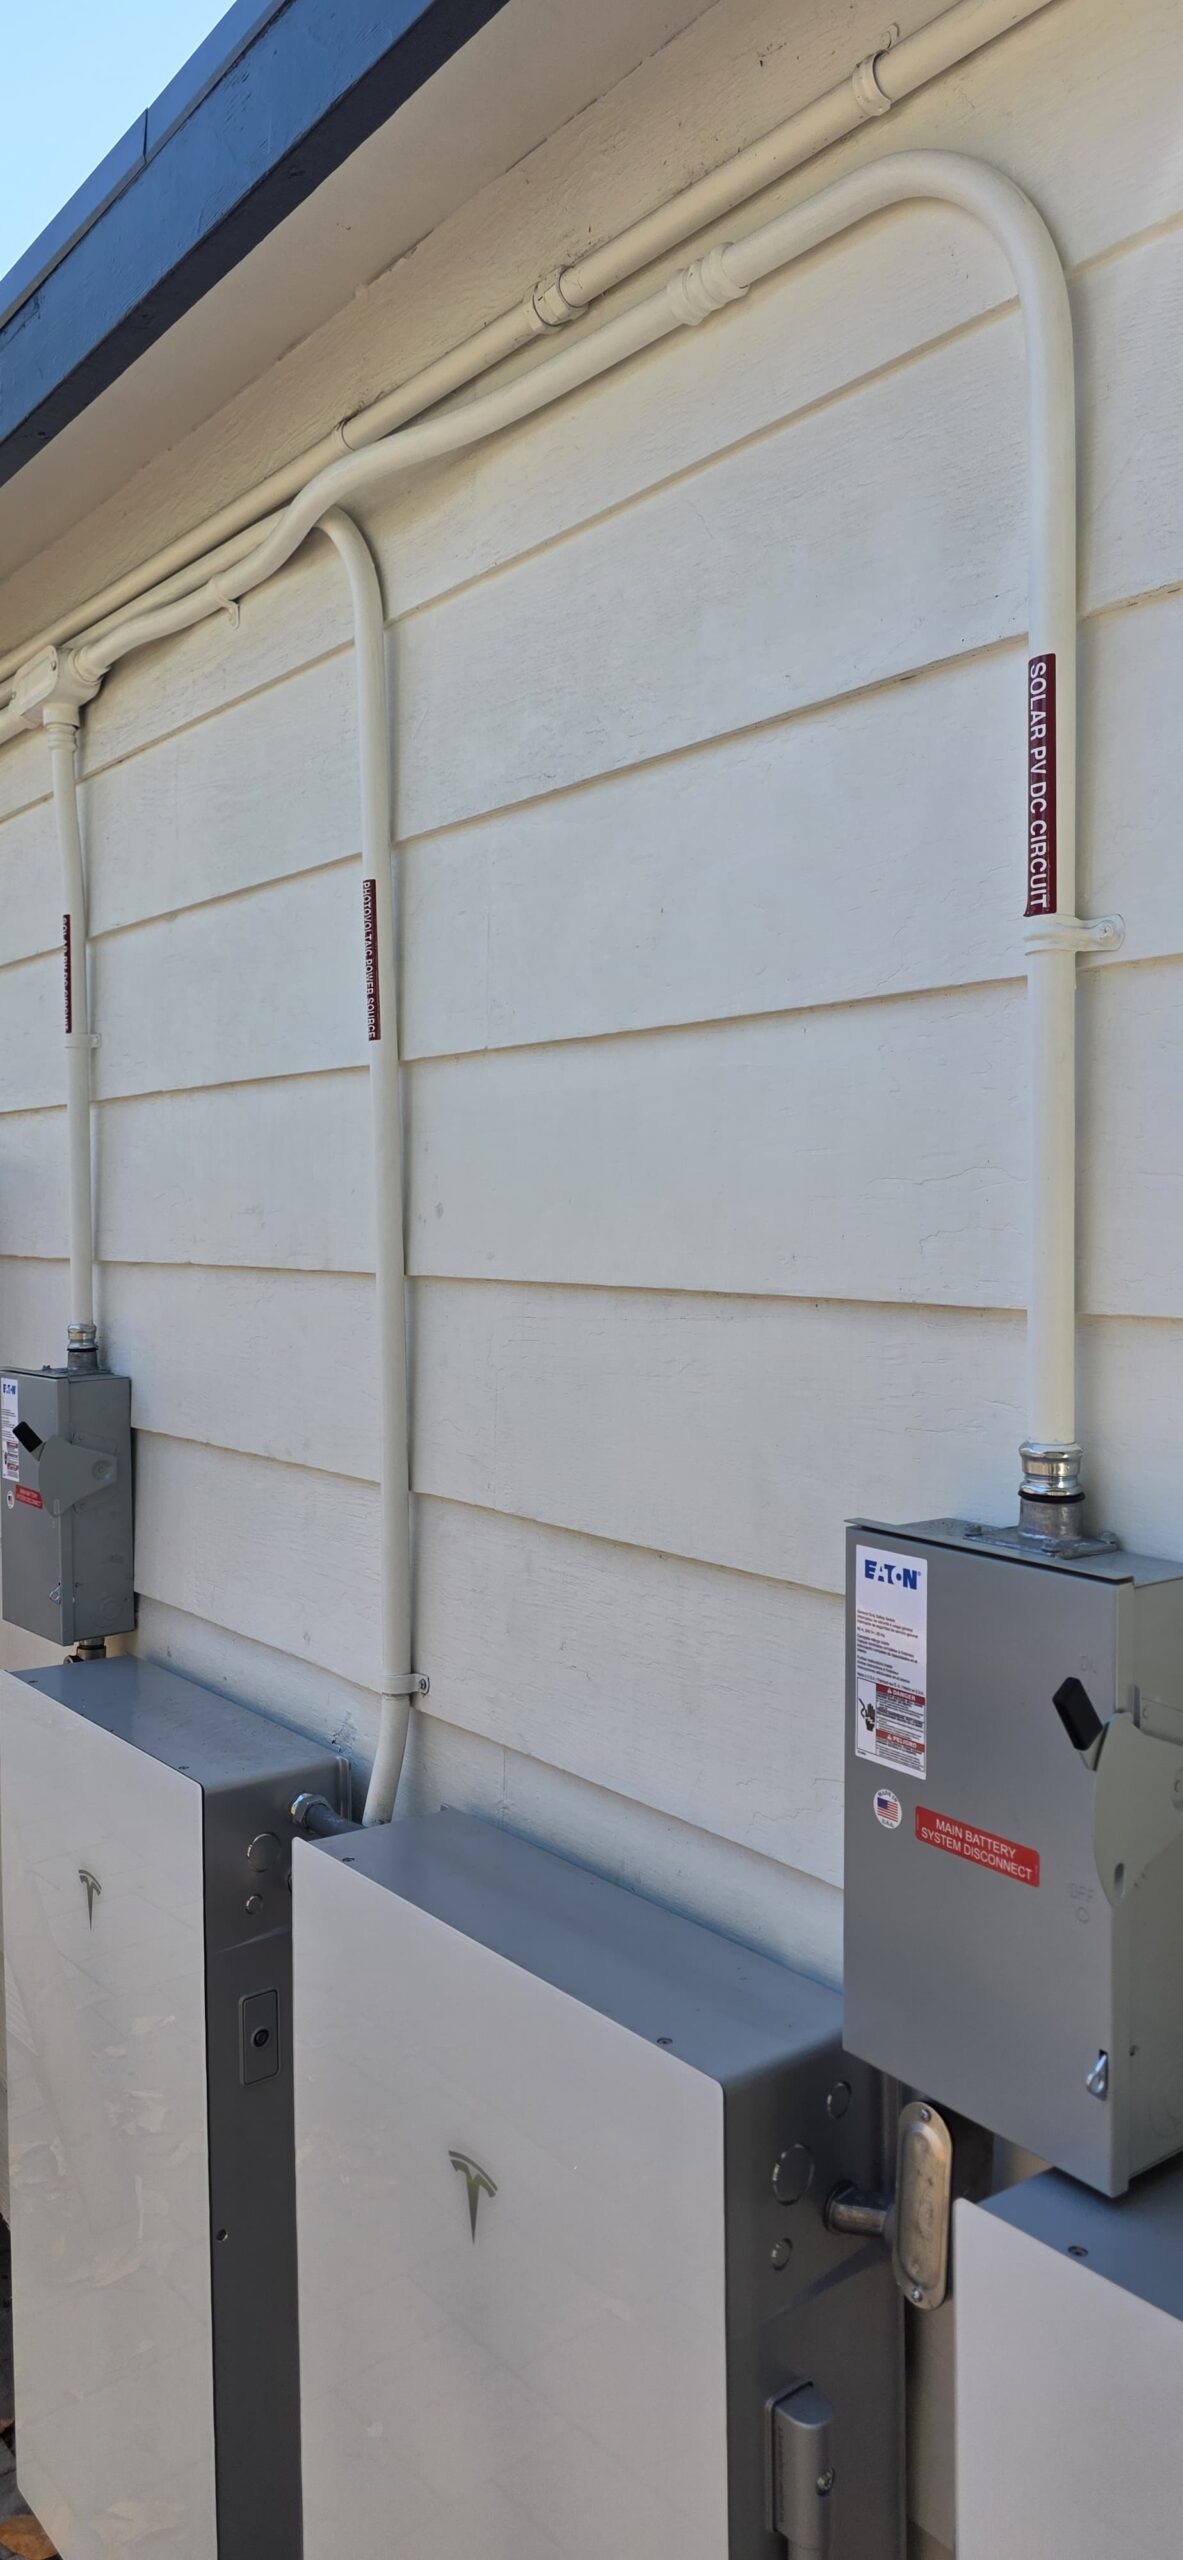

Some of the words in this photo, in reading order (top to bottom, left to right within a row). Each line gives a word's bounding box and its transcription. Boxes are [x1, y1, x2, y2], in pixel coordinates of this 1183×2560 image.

[1029, 661, 1047, 740] SOLAR
[1030, 748, 1047, 774] PV
[1030, 784, 1047, 814] DC
[1030, 819, 1047, 908] CIRCUIT
[363, 882, 373, 957] PHOTOVOLTAIC
[366, 958, 374, 995] POWER
[367, 997, 376, 1039] SOURCE
[864, 1559, 918, 1590] EATON
[921, 1827, 961, 1852] SYSTEM
[963, 1843, 1033, 1880] DISCONNECT
[935, 1818, 963, 1839] MAIN
[965, 1830, 1016, 1859] BATTERY
